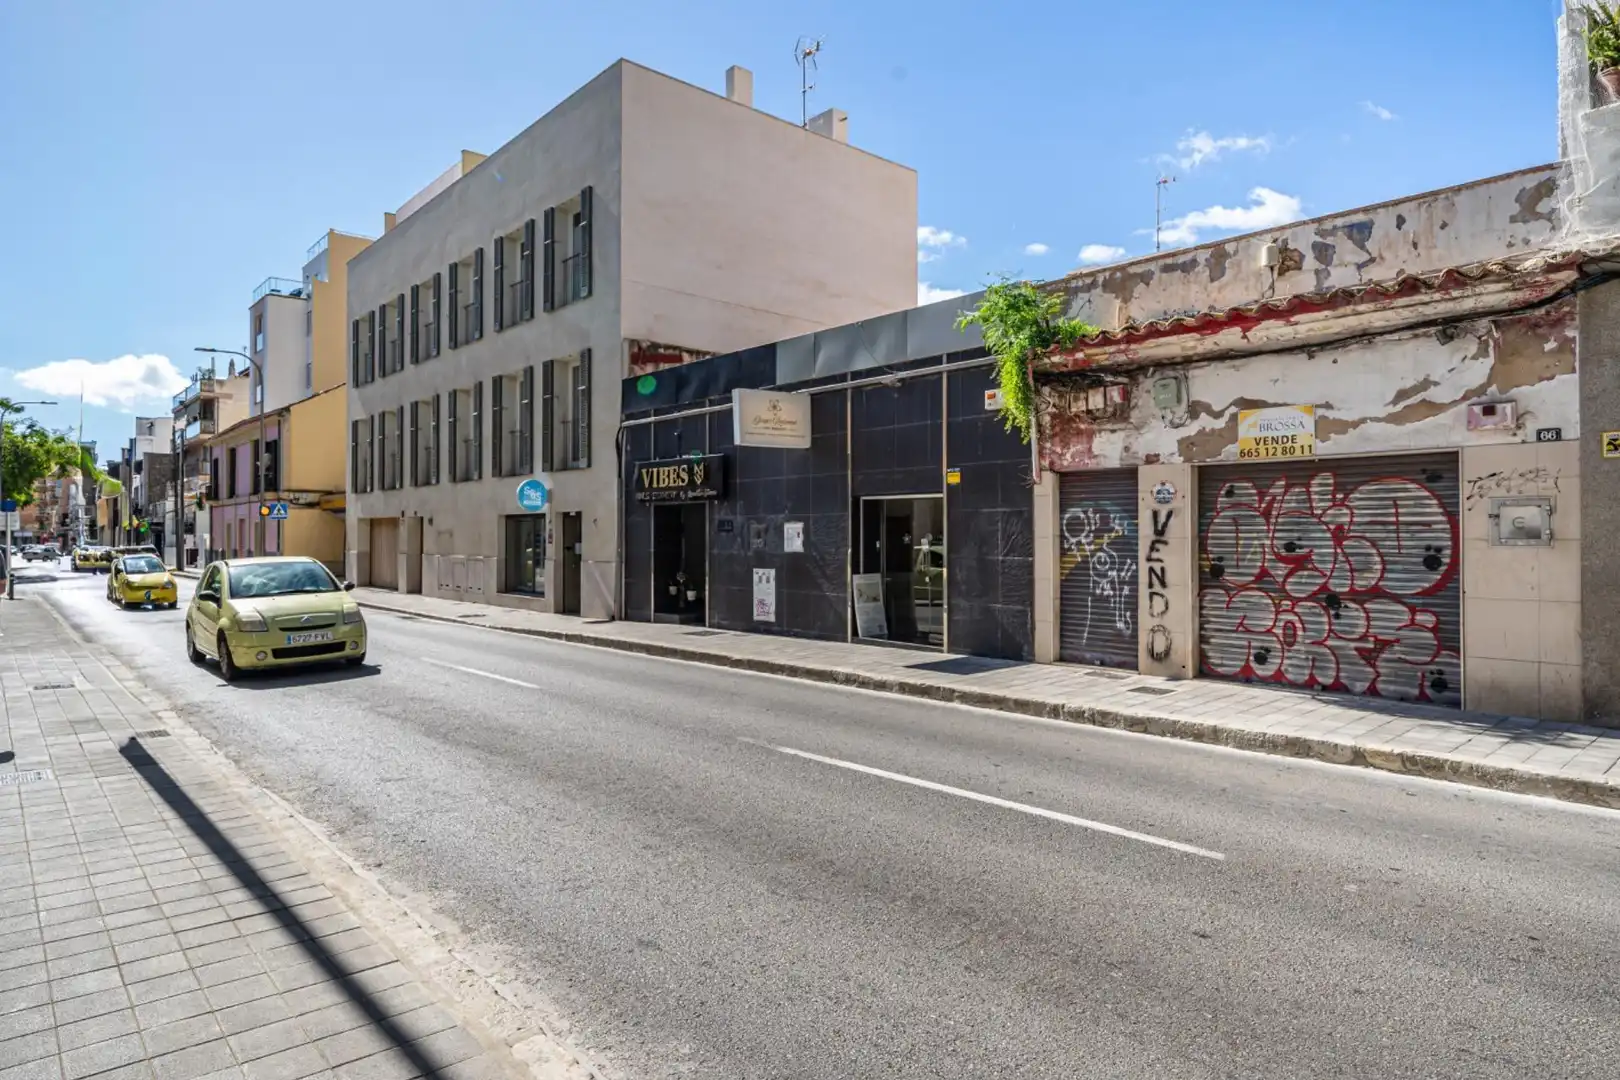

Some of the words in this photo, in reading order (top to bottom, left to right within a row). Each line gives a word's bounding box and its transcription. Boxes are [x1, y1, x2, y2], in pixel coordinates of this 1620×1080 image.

[1259, 420, 1305, 432] BROSSA
[1254, 434, 1298, 446] VENDE
[1540, 430, 1557, 440] 66
[1240, 447, 1260, 458] 665
[1265, 446, 1278, 457] 12
[1281, 446, 1296, 456] 80
[1300, 444, 1313, 455] 11
[641, 464, 689, 488] VIBES
[1146, 509, 1172, 661] VENDO
